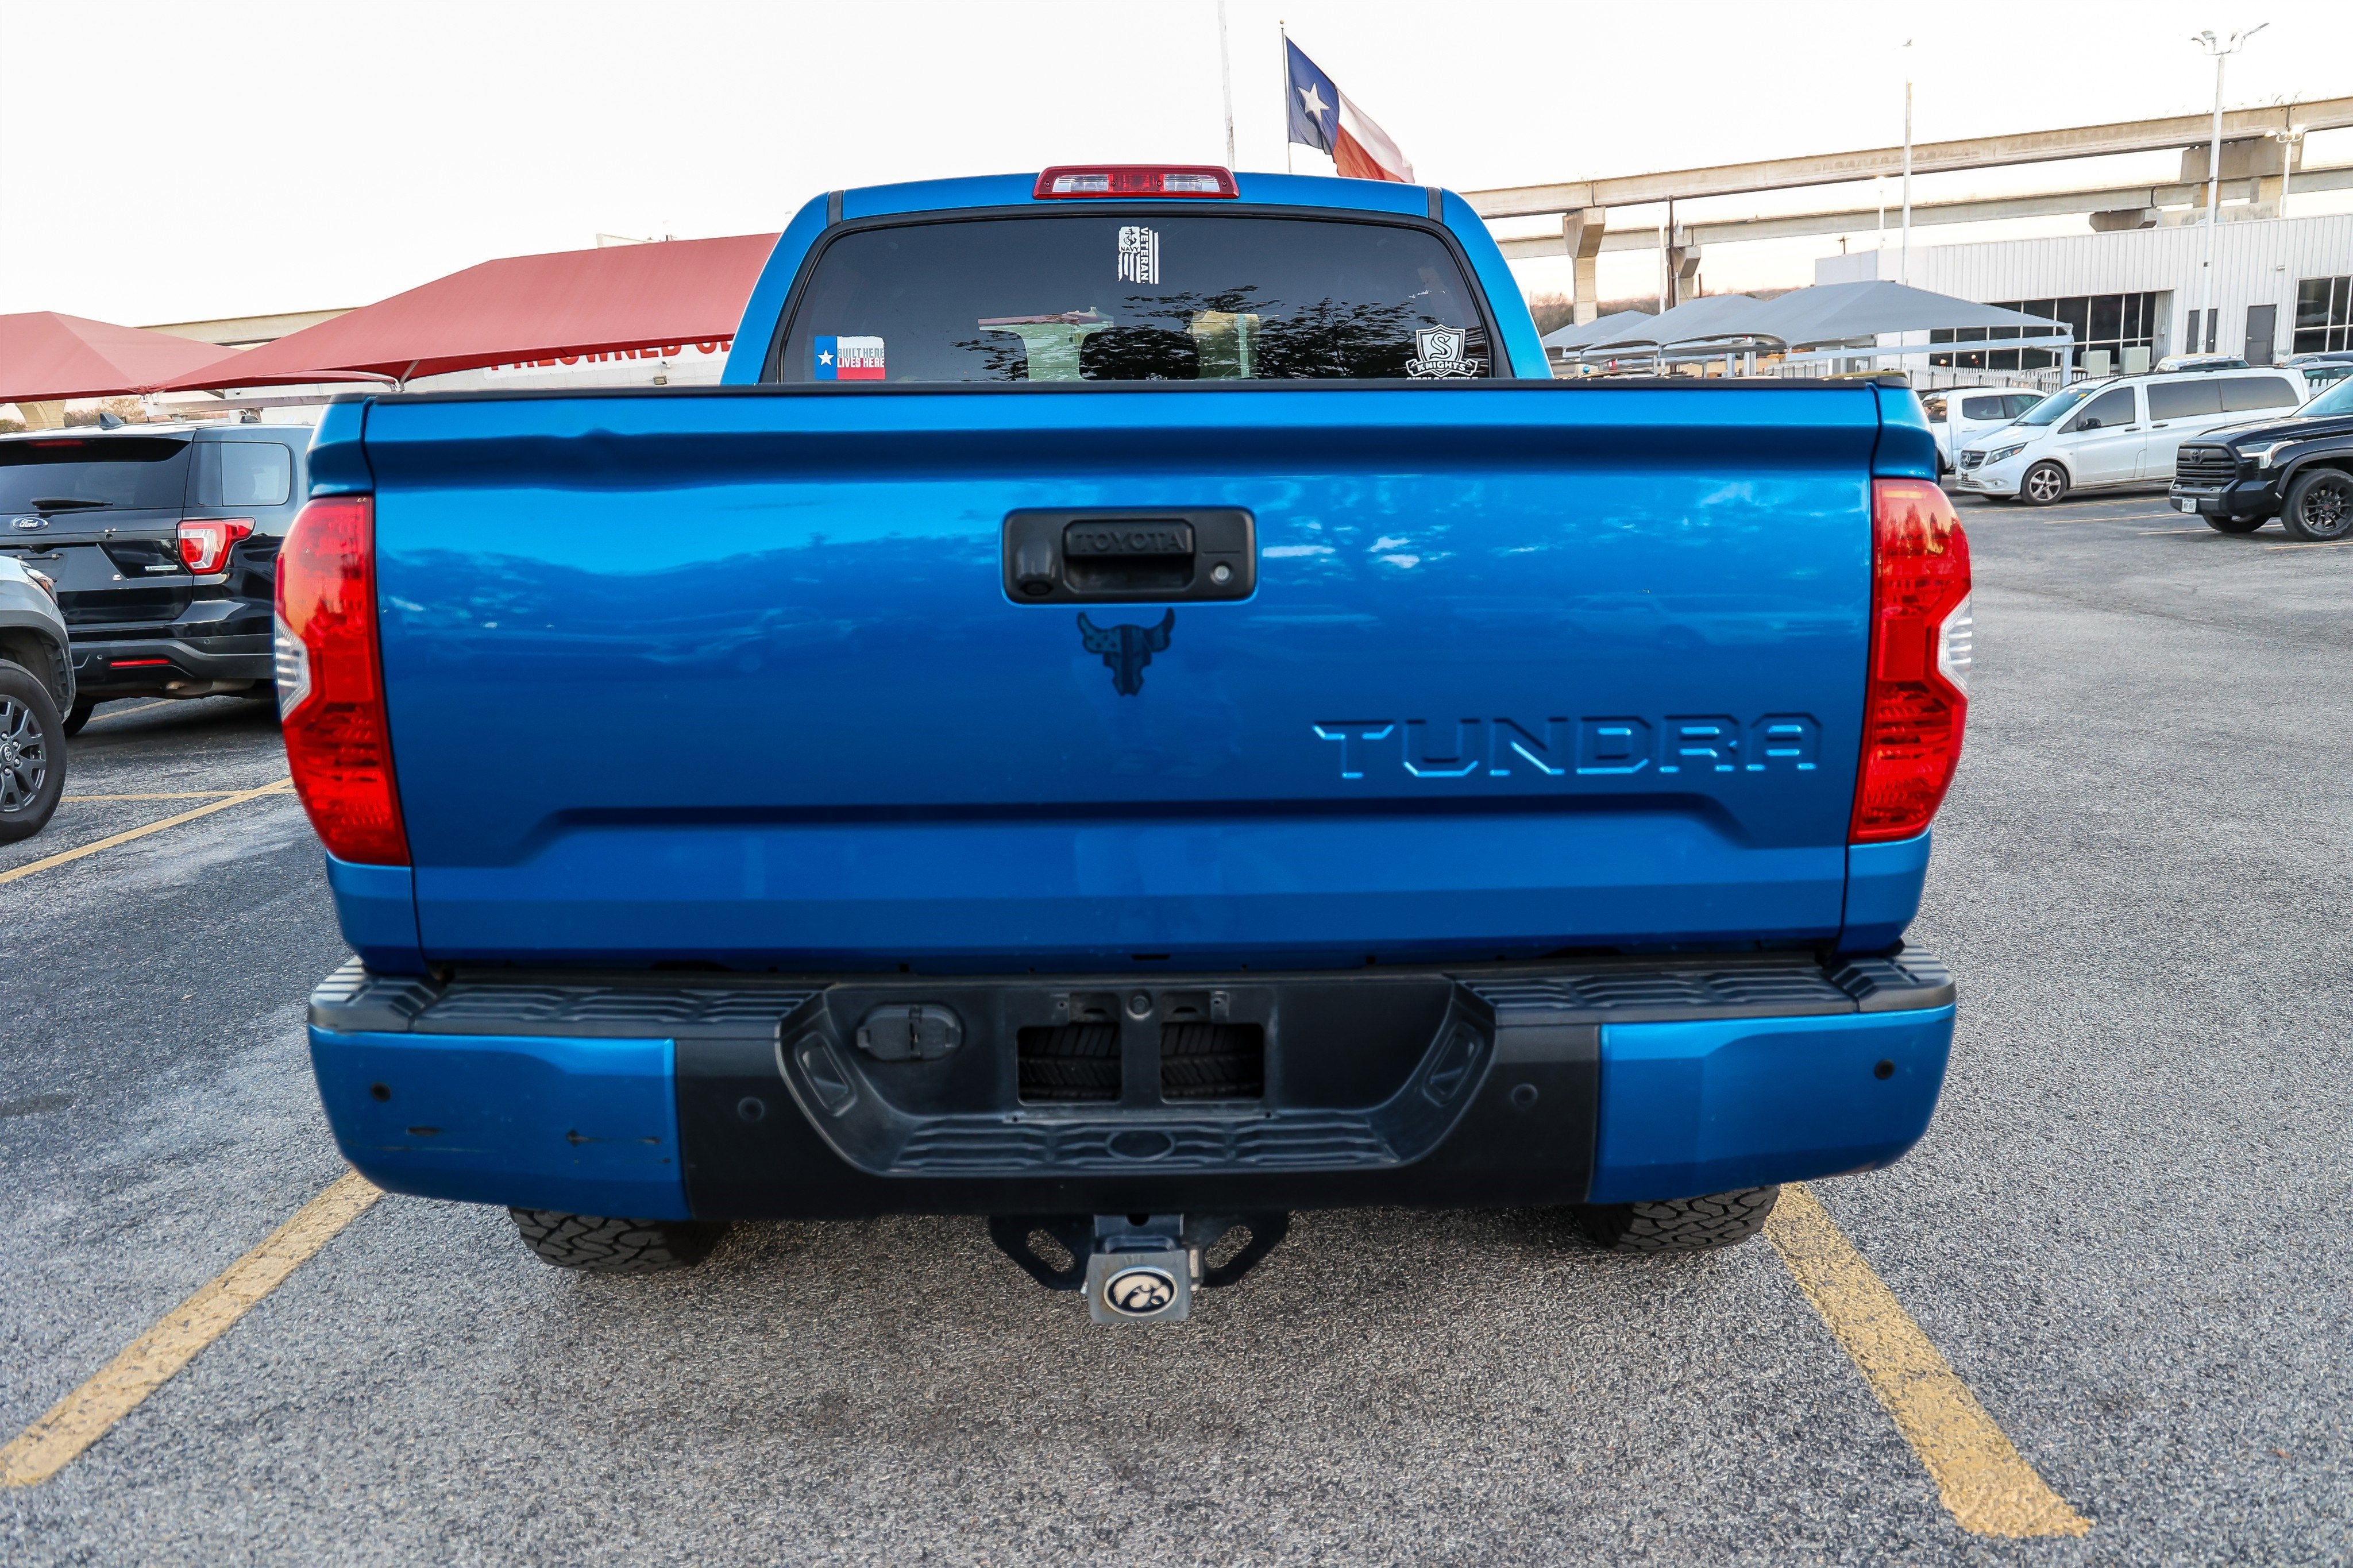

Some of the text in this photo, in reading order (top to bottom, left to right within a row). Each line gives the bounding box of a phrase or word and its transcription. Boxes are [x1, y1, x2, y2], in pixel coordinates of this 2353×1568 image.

[1140, 227, 1149, 280] VETERAN
[837, 348, 884, 358] BUILT HERE
[1429, 333, 1453, 360] S
[837, 358, 885, 368] LIVES HERE
[1417, 361, 1465, 372] KNIGHTS
[19, 519, 38, 527] Ford
[1074, 530, 1186, 553] TOYOTA
[1313, 713, 1822, 778] TUNDRA
